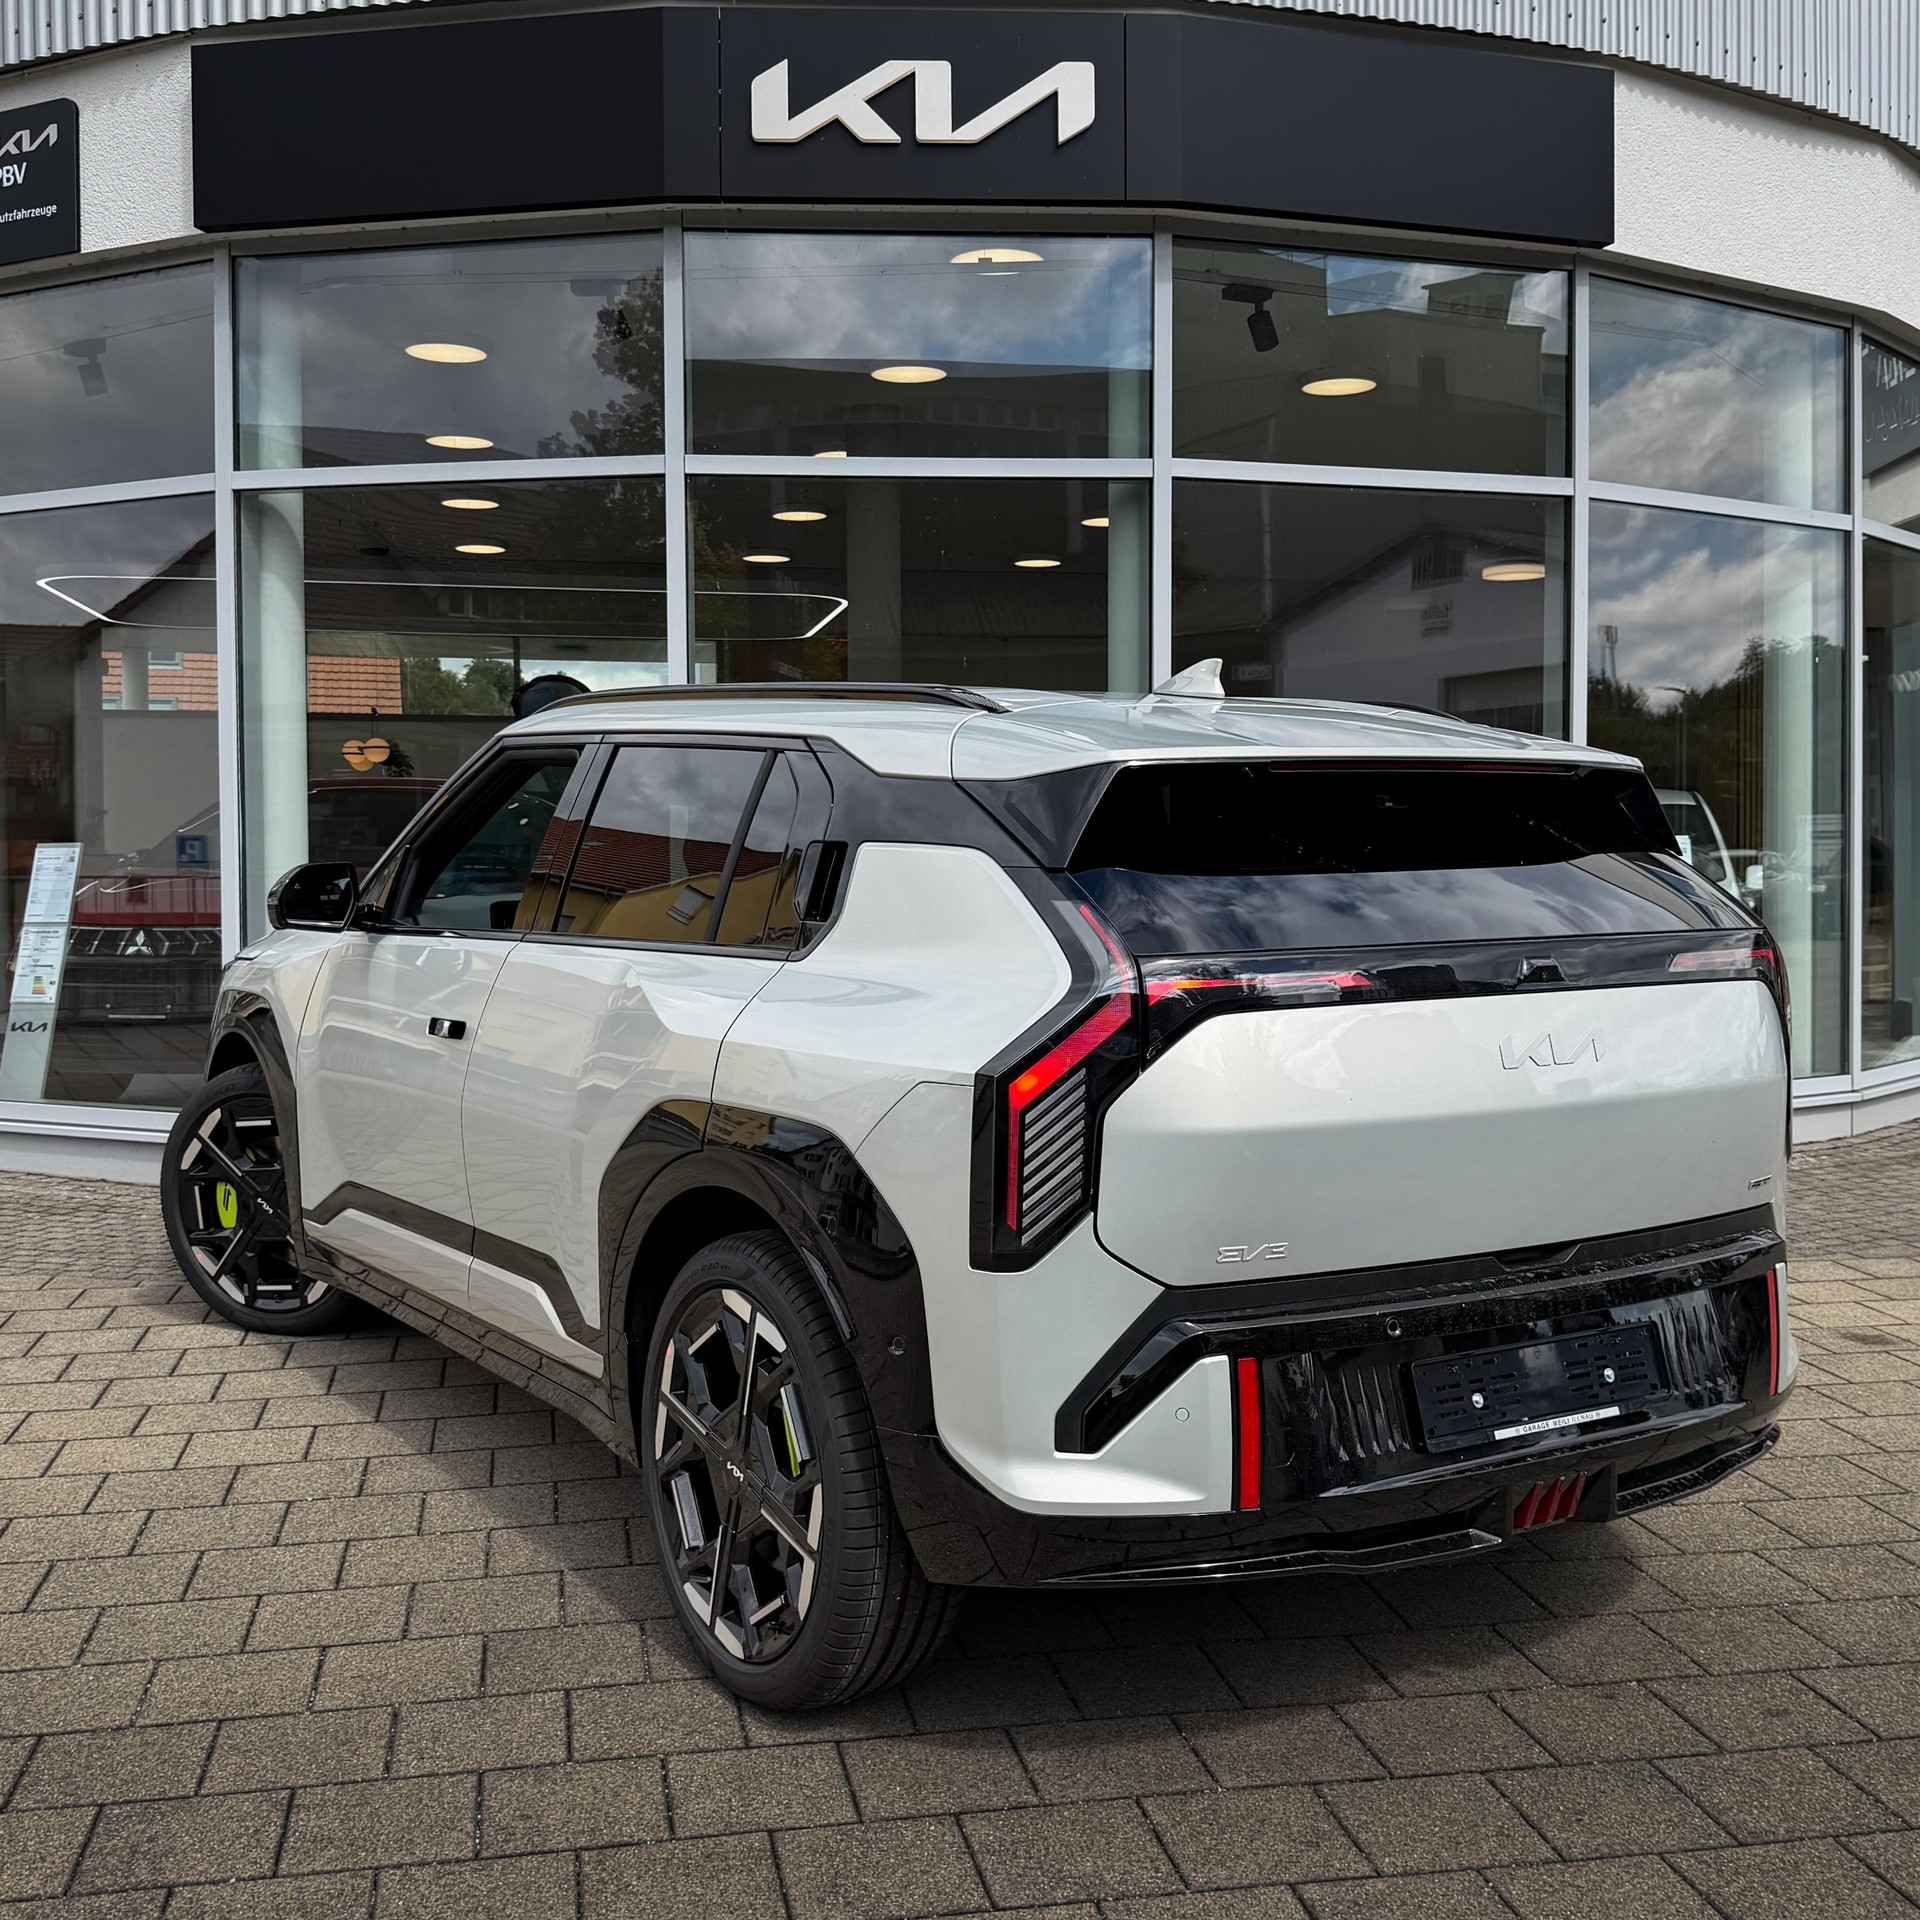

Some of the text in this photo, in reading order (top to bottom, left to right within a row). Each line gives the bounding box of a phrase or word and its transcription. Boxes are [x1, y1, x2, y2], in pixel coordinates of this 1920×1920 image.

[751, 58, 1096, 145] KIA
[10, 1021, 48, 1032] KIA
[1498, 1027, 1607, 1070] KIA
[1216, 1242, 1289, 1263] EV3
[1522, 1421, 1550, 1433] GARAGE
